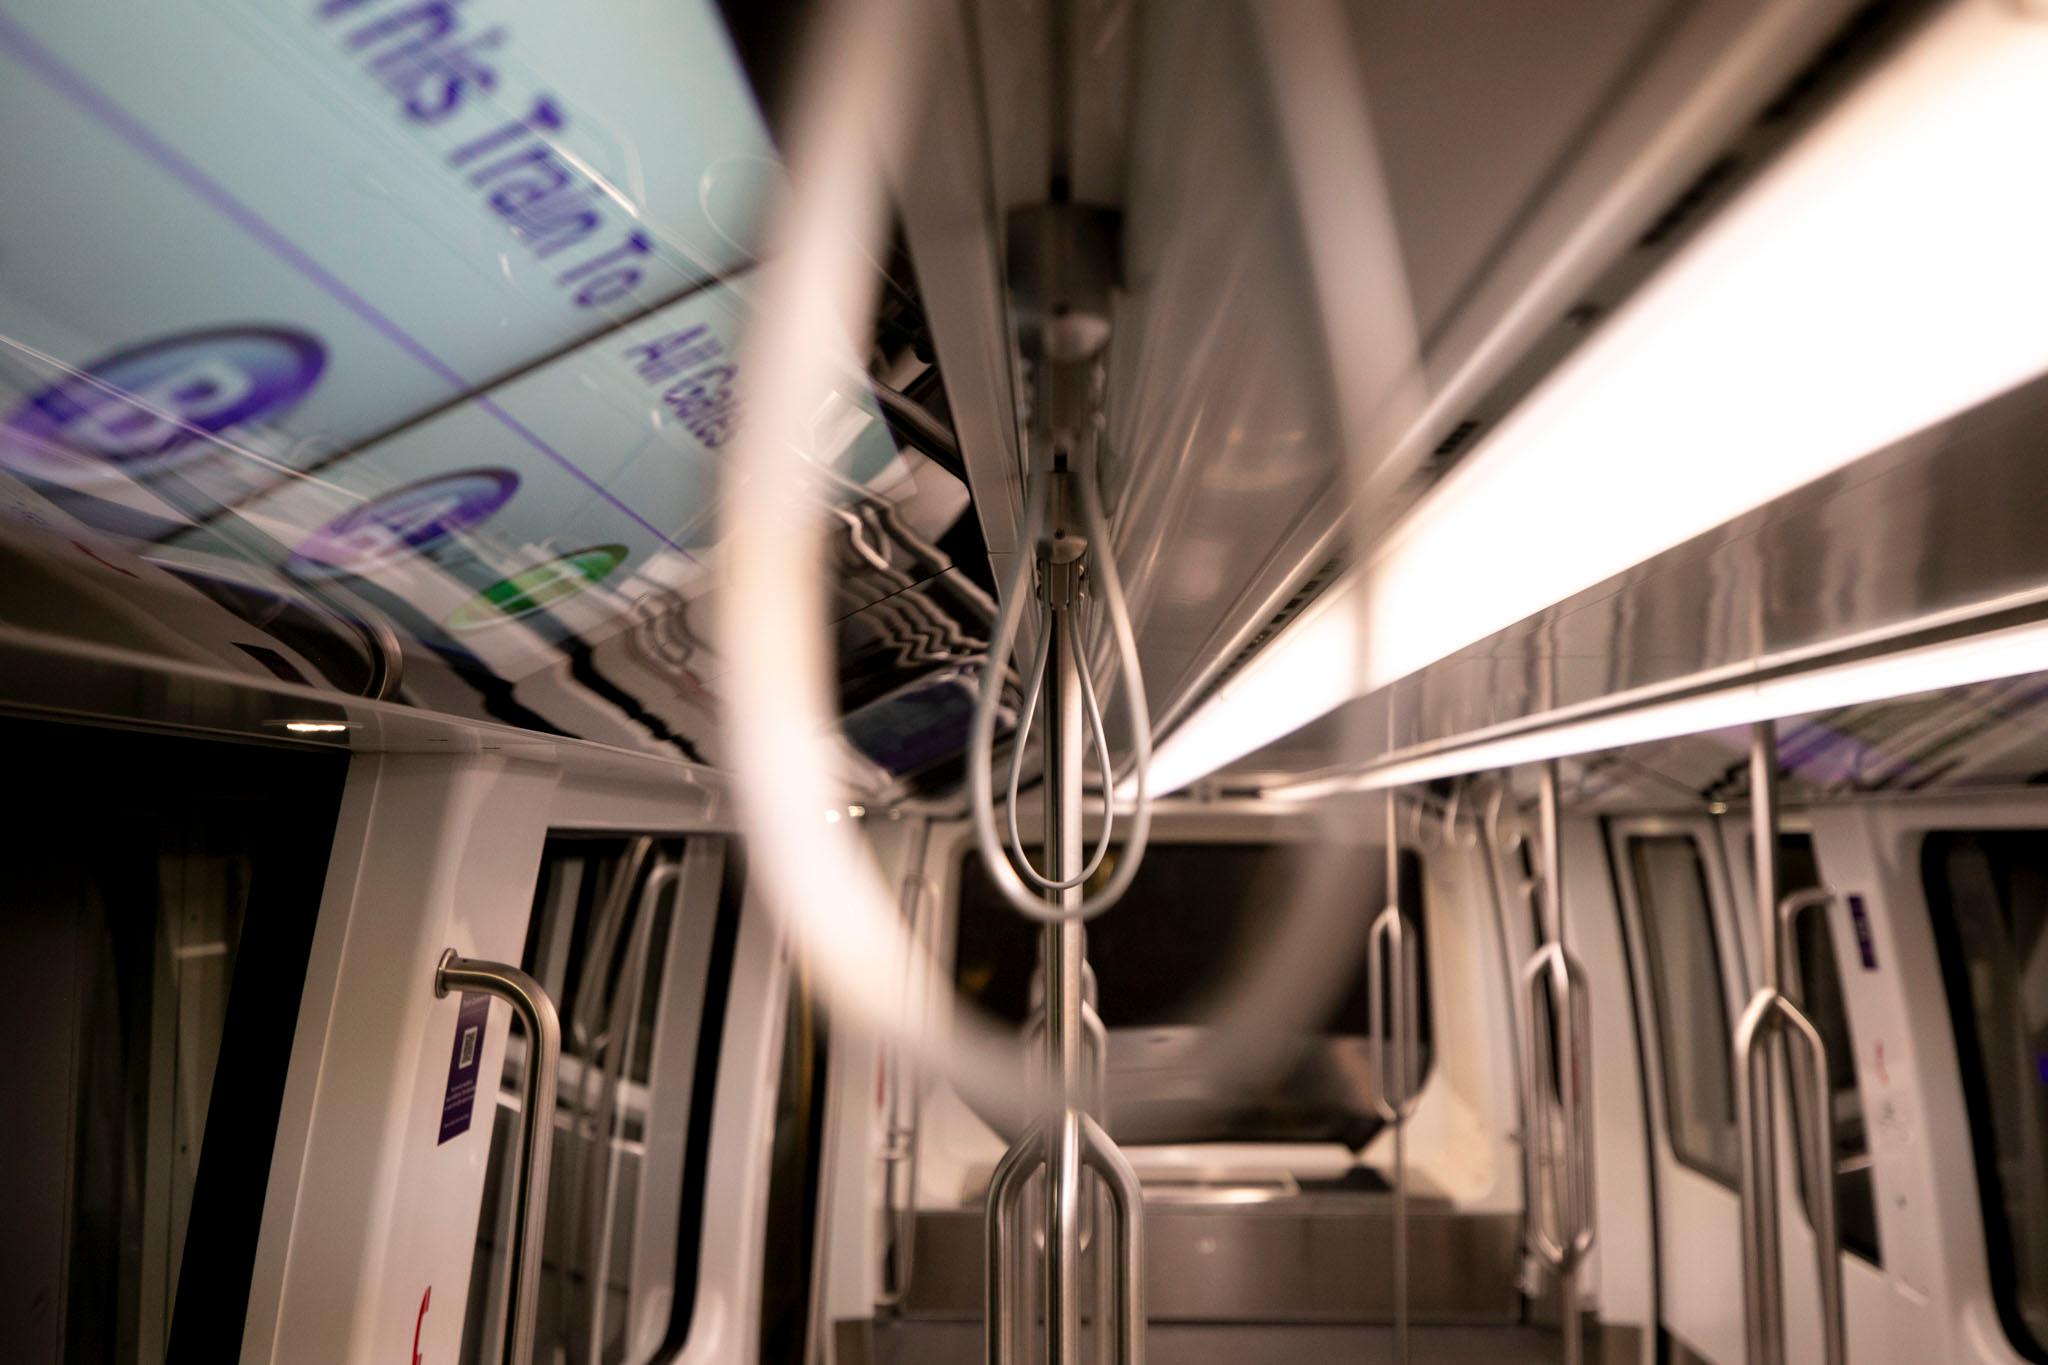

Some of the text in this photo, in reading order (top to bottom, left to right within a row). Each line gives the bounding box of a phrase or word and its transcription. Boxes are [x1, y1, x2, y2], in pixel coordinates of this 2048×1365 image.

[446, 94, 604, 260] Train
[556, 227, 653, 307] To
[622, 322, 724, 384] All
